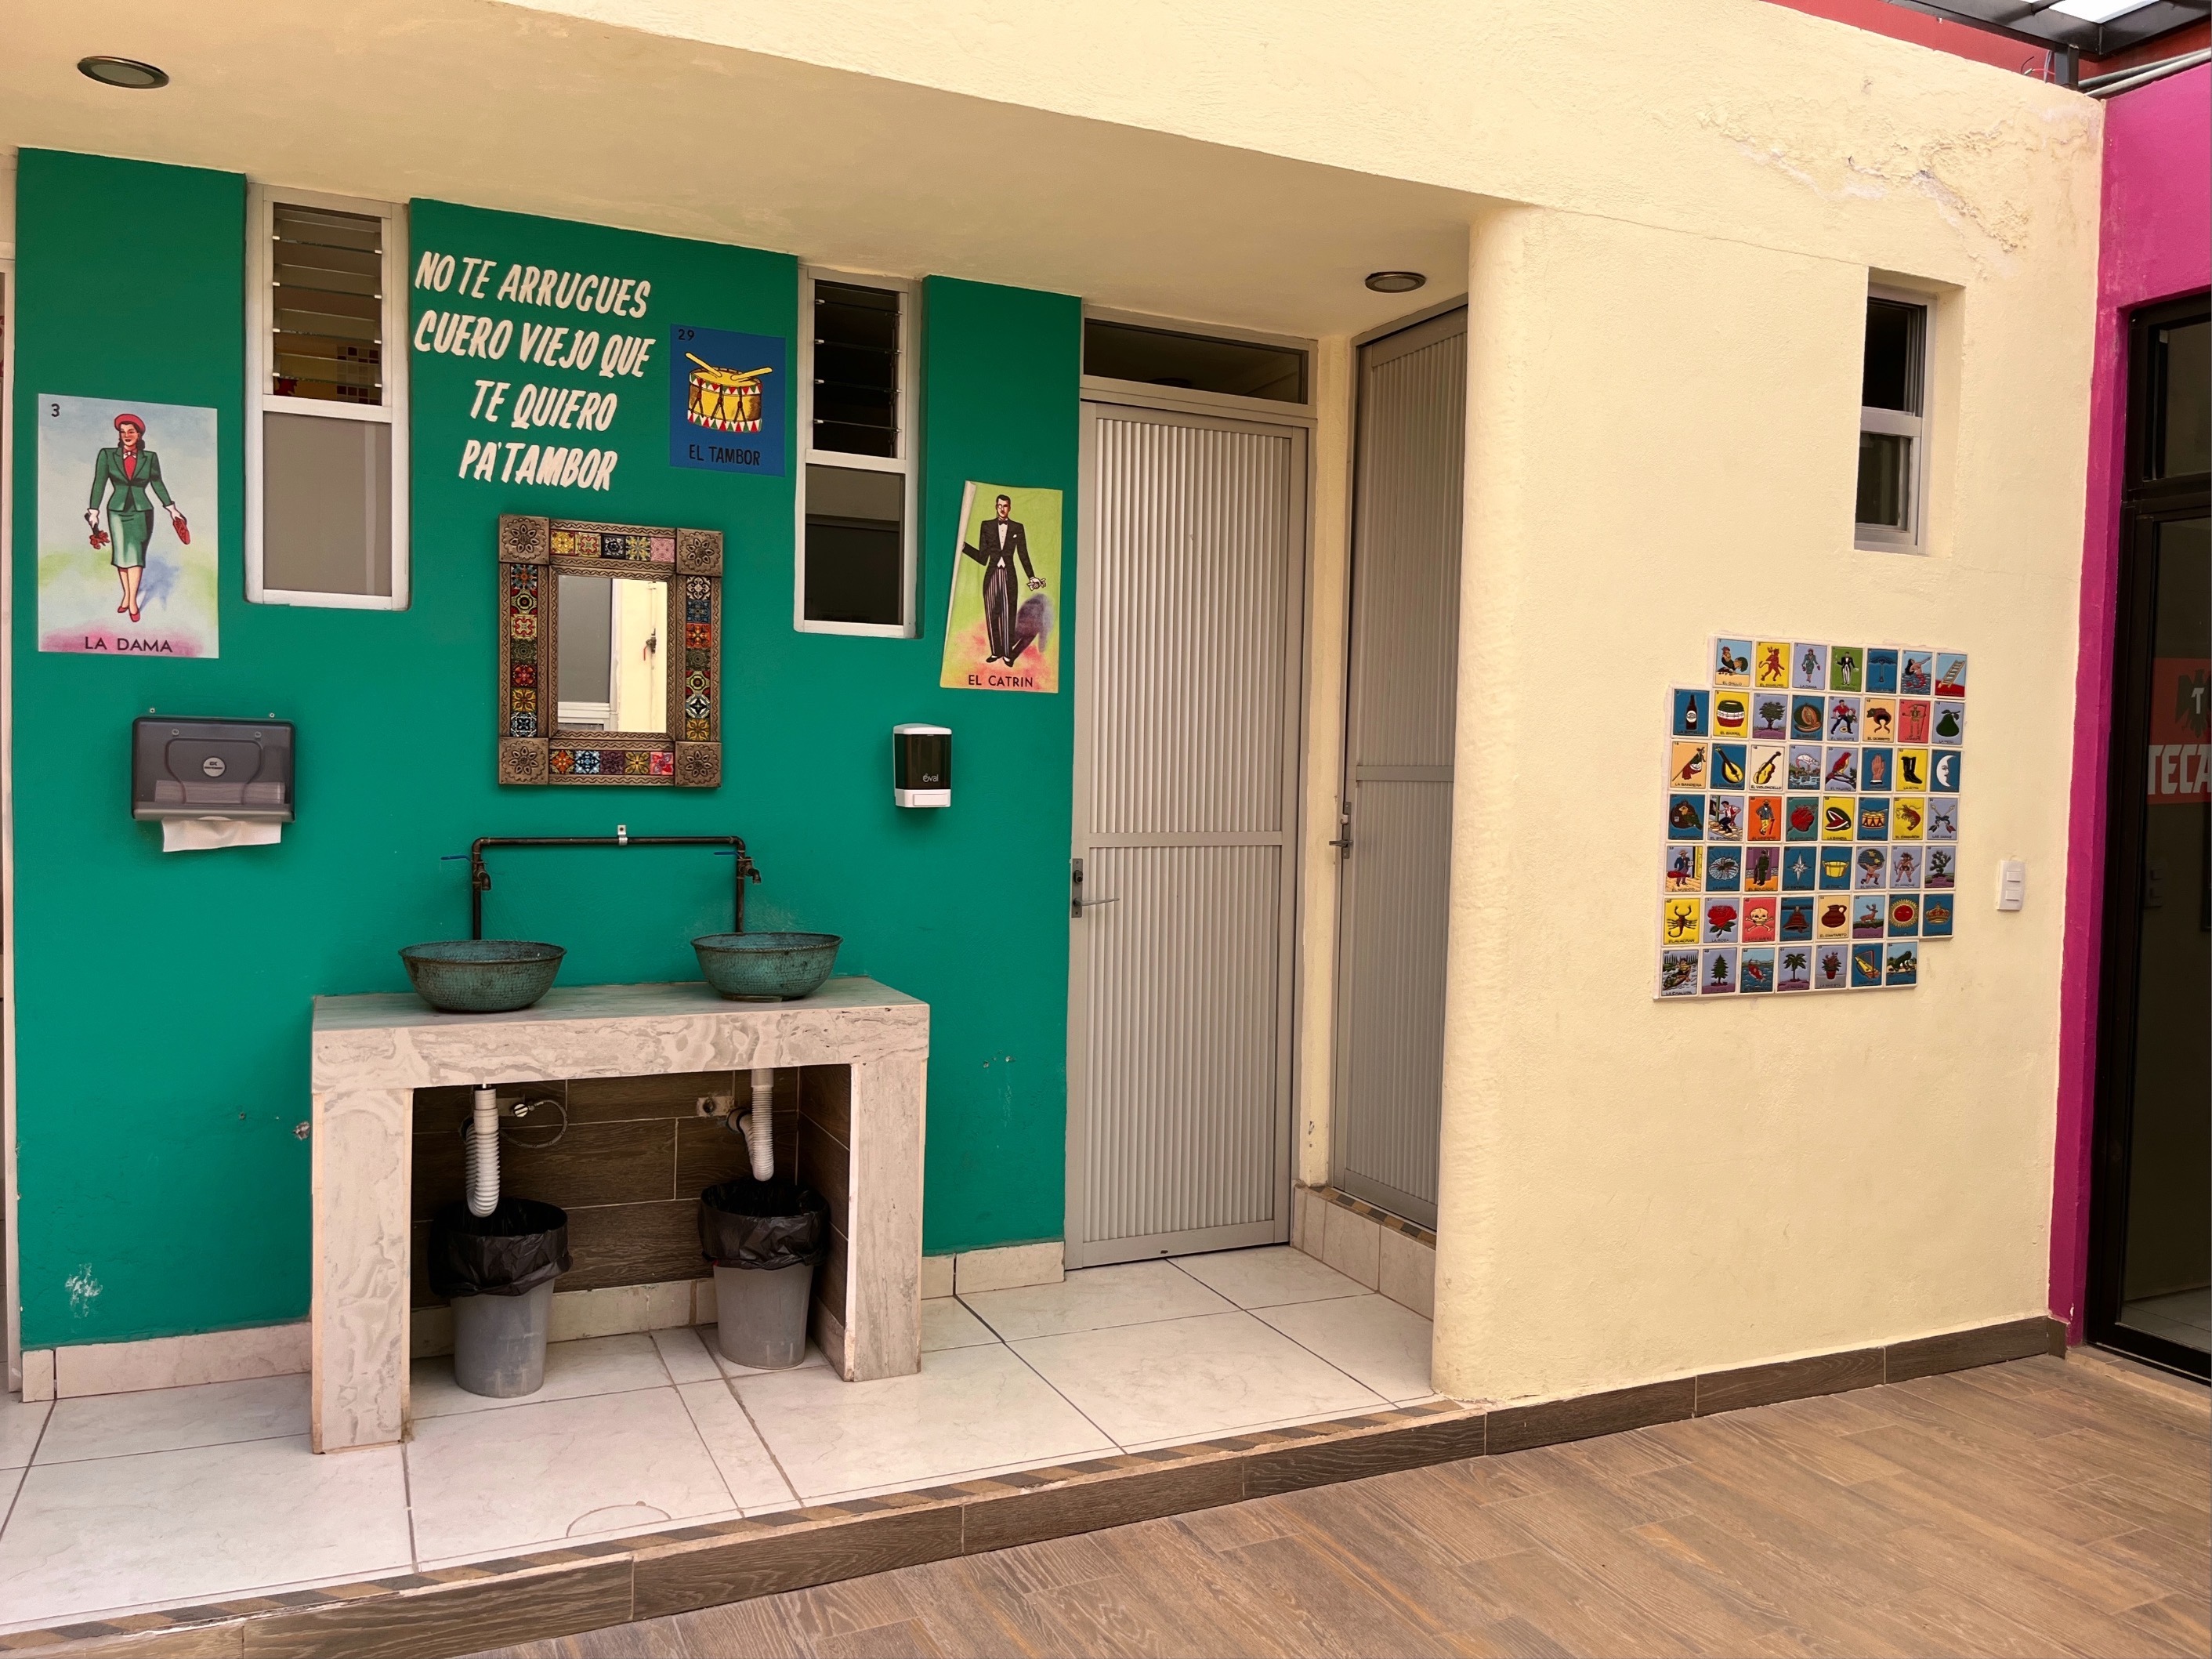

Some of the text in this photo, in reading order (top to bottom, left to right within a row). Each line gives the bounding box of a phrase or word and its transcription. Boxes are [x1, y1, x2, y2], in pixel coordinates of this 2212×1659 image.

[415, 251, 652, 319] NO TE ARRUGUES
[414, 310, 657, 378] CUERO VIEJO QUE
[678, 328, 695, 342] 29
[51, 404, 60, 418] 3
[470, 379, 617, 432] TE QUIERO
[689, 444, 762, 466] EL TAMBOR
[85, 636, 173, 654] LA DAMA
[968, 674, 1034, 688] EL CATRIN
